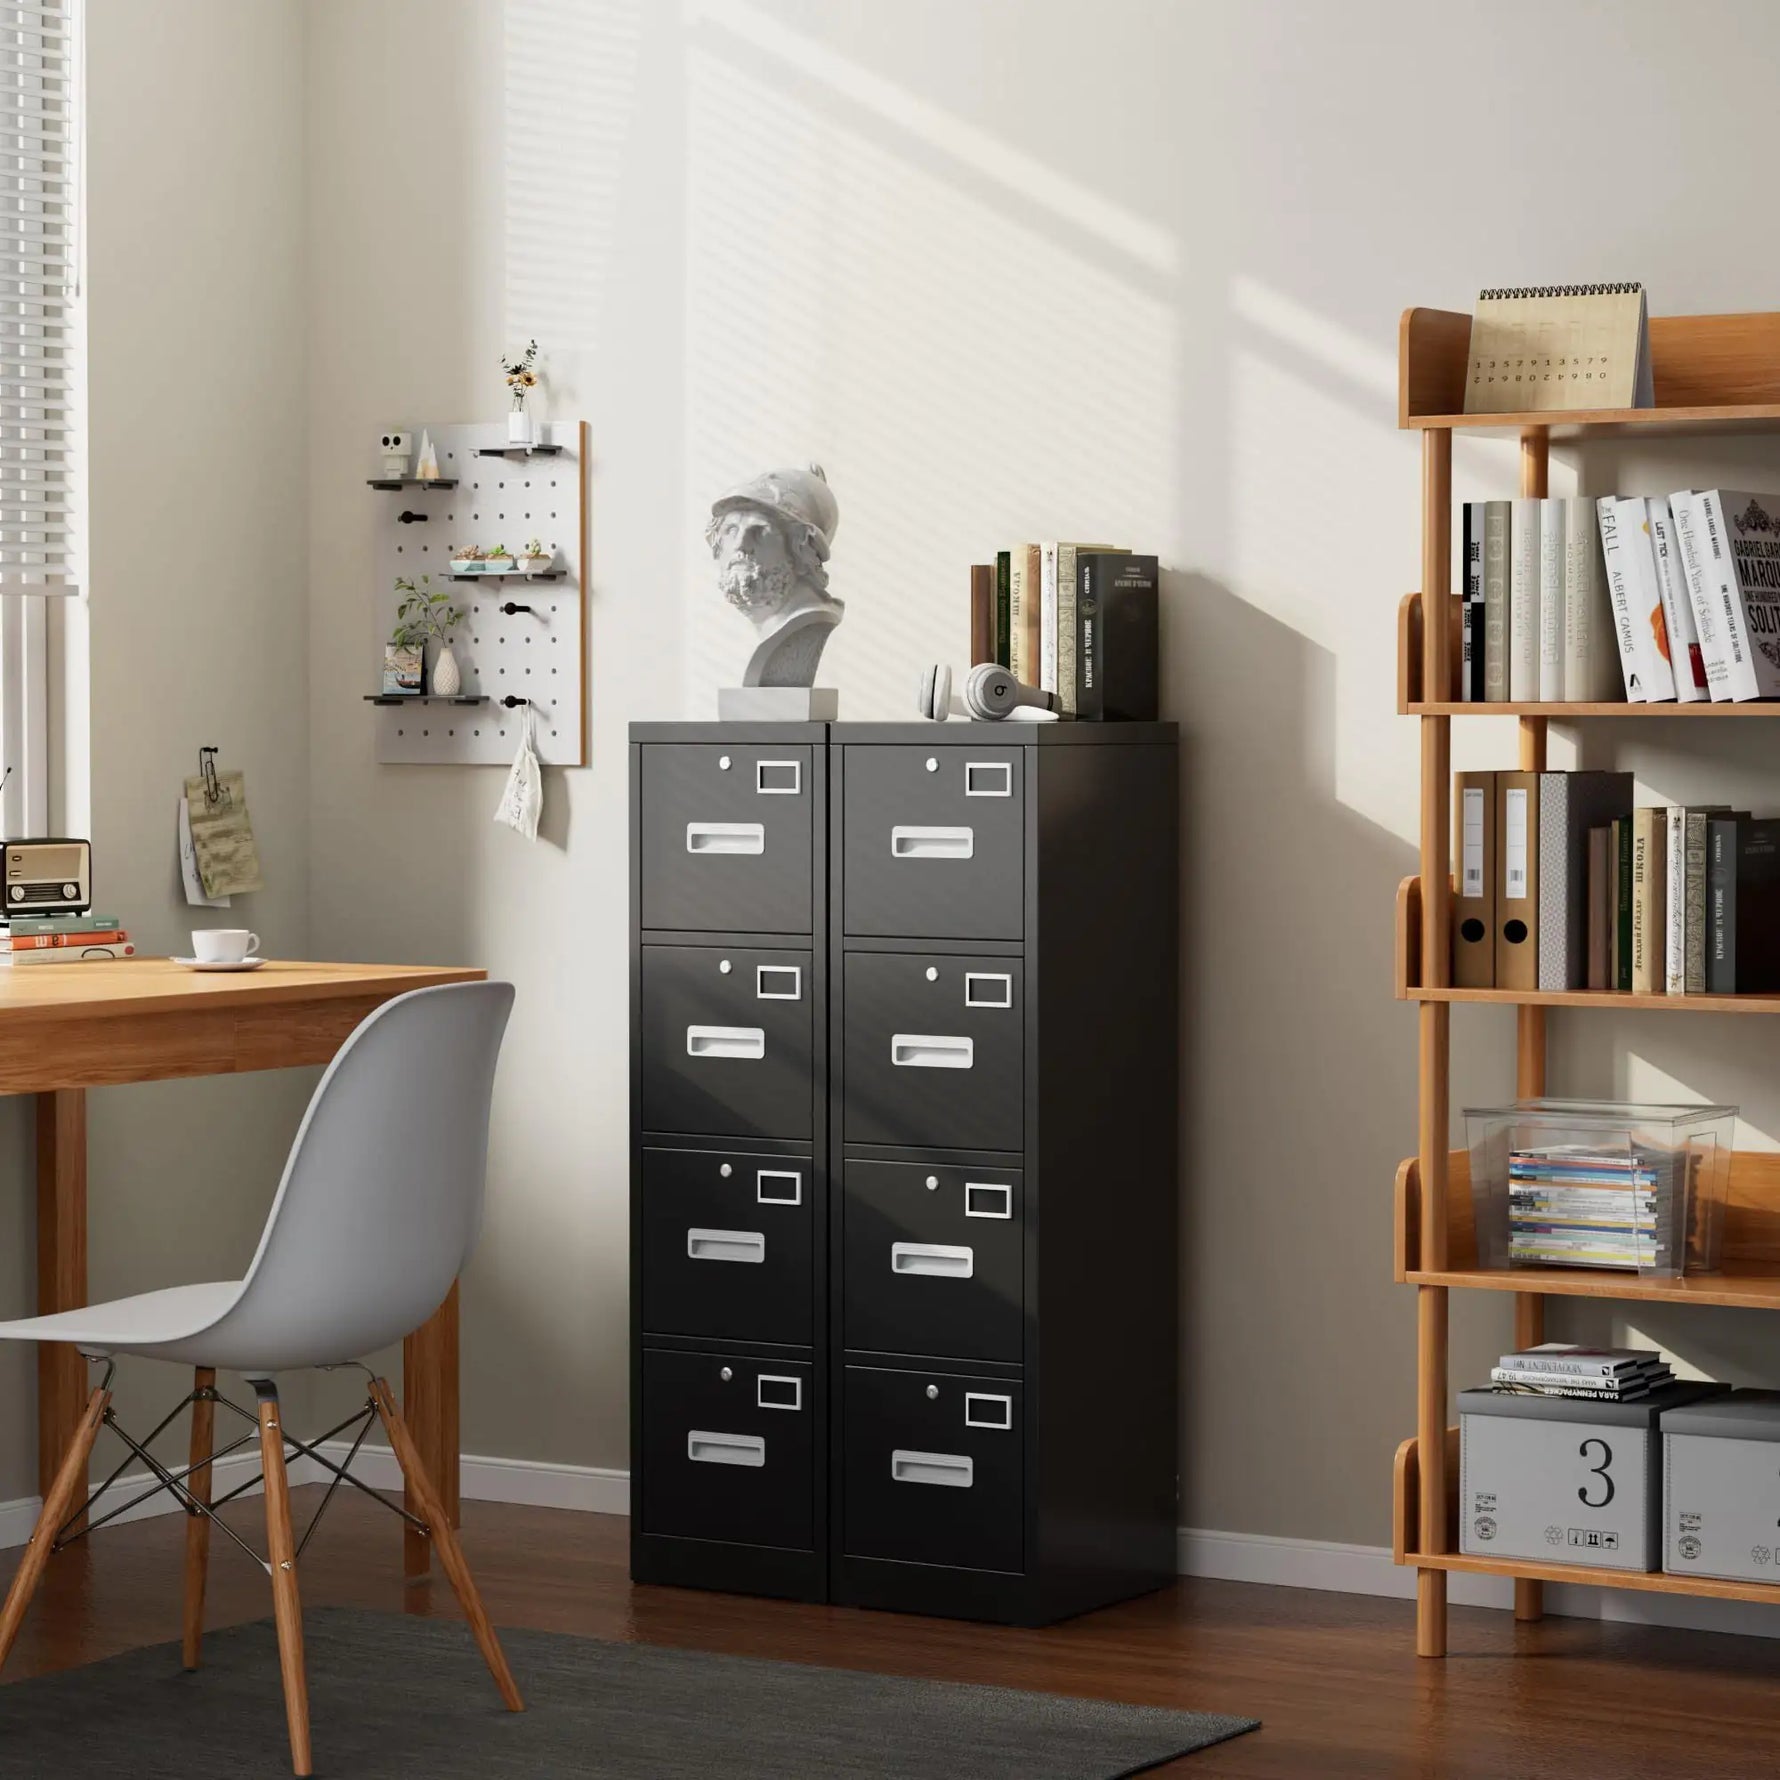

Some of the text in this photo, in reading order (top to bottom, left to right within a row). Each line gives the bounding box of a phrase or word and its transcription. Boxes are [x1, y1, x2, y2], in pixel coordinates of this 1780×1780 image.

[1655, 521, 1667, 558] LAST TICK
[1734, 540, 1765, 558] GABRIEL
[1602, 515, 1619, 556] FALL
[1612, 570, 1627, 611] ALBERT
[1620, 616, 1634, 652] CAMUS
[1679, 509, 1715, 643] One Hundred Years of Solitude
[1635, 838, 1645, 883] ШКОЛА
[1598, 1391, 1619, 1399] SARA
[1578, 1438, 1615, 1508] 3
